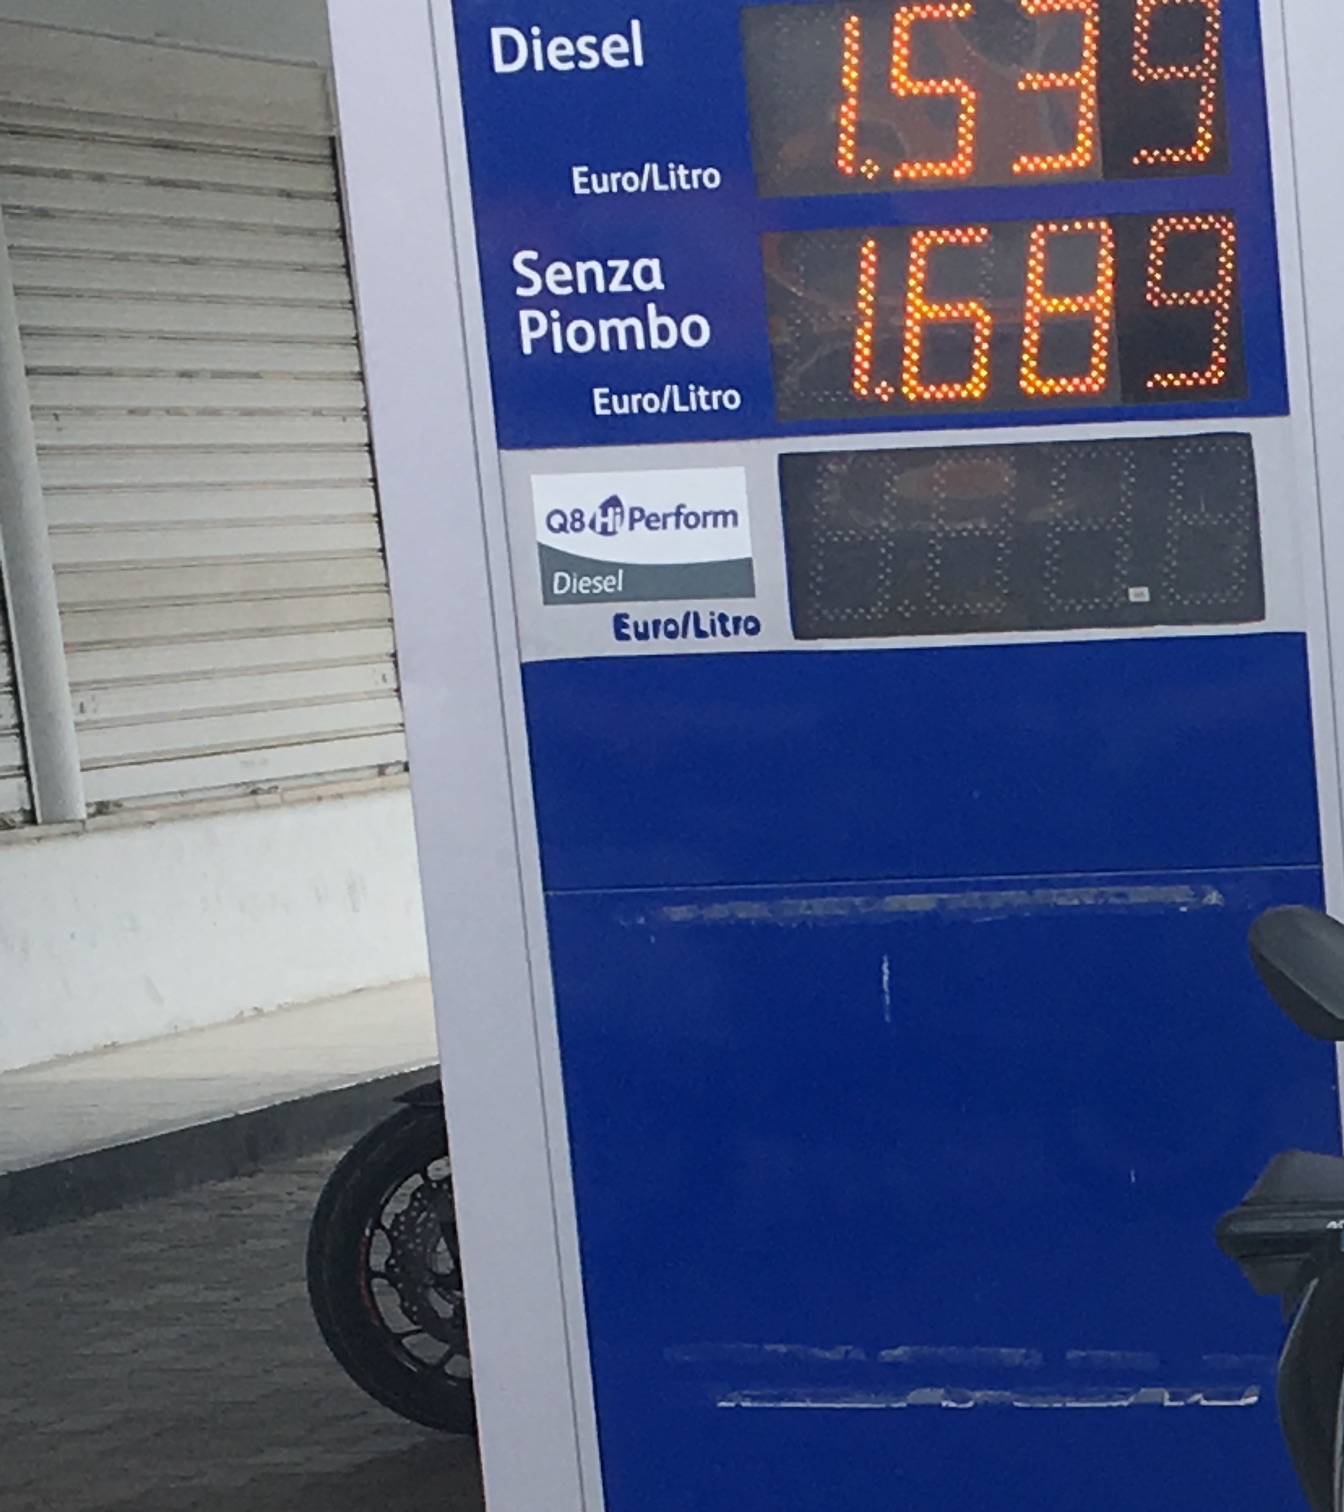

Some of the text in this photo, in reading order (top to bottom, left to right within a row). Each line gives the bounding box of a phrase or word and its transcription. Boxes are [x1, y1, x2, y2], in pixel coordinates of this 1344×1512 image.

[490, 18, 644, 74] Diesel
[572, 162, 722, 195] Euro/Litro
[512, 249, 665, 297] Senza
[850, 213, 1238, 402] 1.689
[518, 302, 711, 355] Piombo
[592, 383, 742, 416] Euro/Litro
[545, 508, 586, 534] Q8
[628, 503, 739, 532] Perform
[552, 568, 624, 595] Diesel
[612, 610, 762, 642] Euro/Litro
